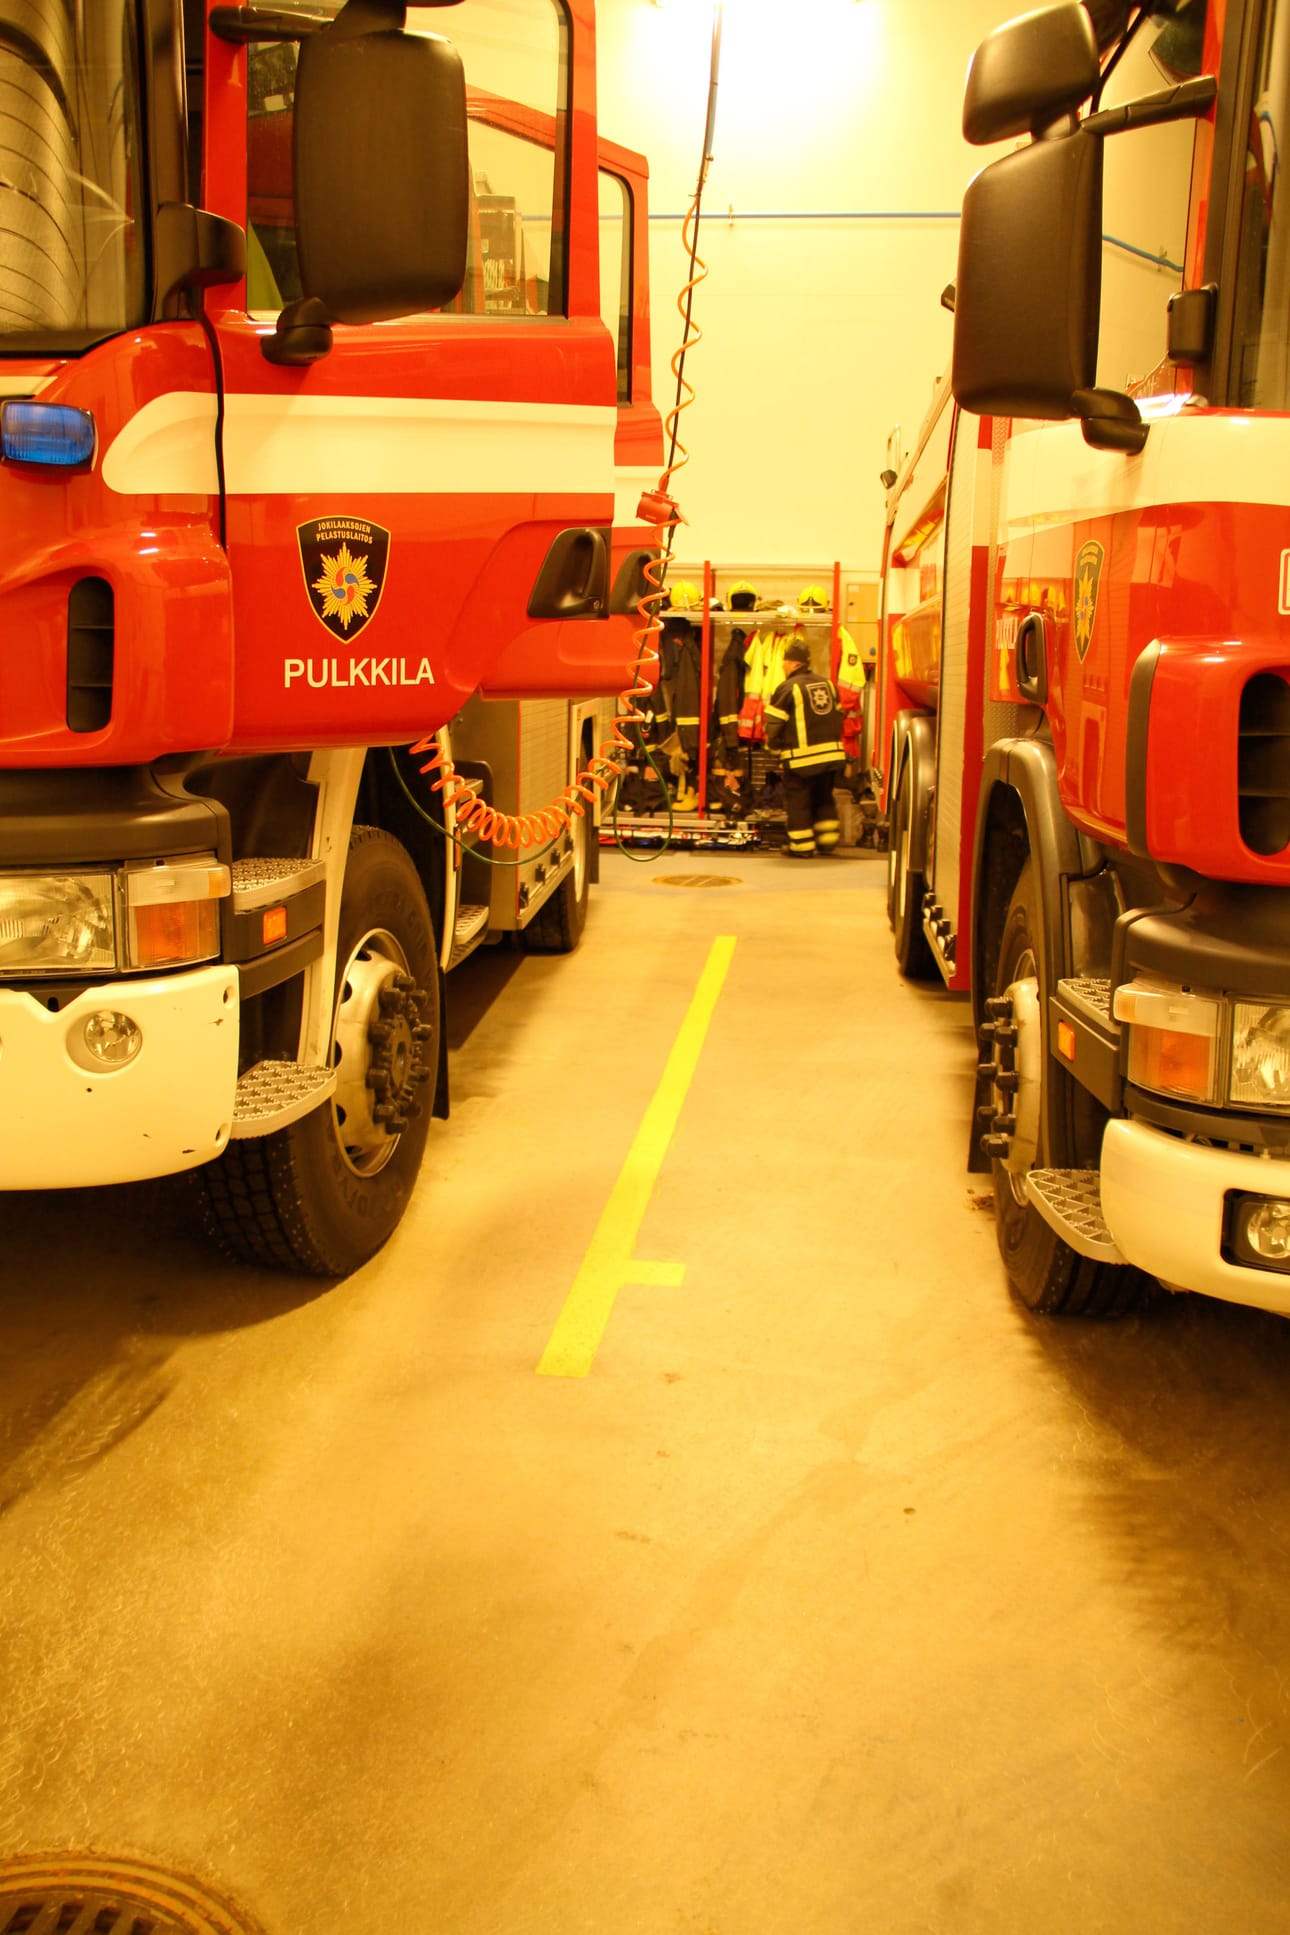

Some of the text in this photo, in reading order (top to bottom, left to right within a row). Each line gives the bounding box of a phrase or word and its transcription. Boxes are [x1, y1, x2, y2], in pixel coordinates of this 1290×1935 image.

[318, 520, 371, 534] JOKILAAKSOJEN
[316, 530, 373, 544] PELASTUSLAITOS
[284, 657, 435, 688] PULKKILA
